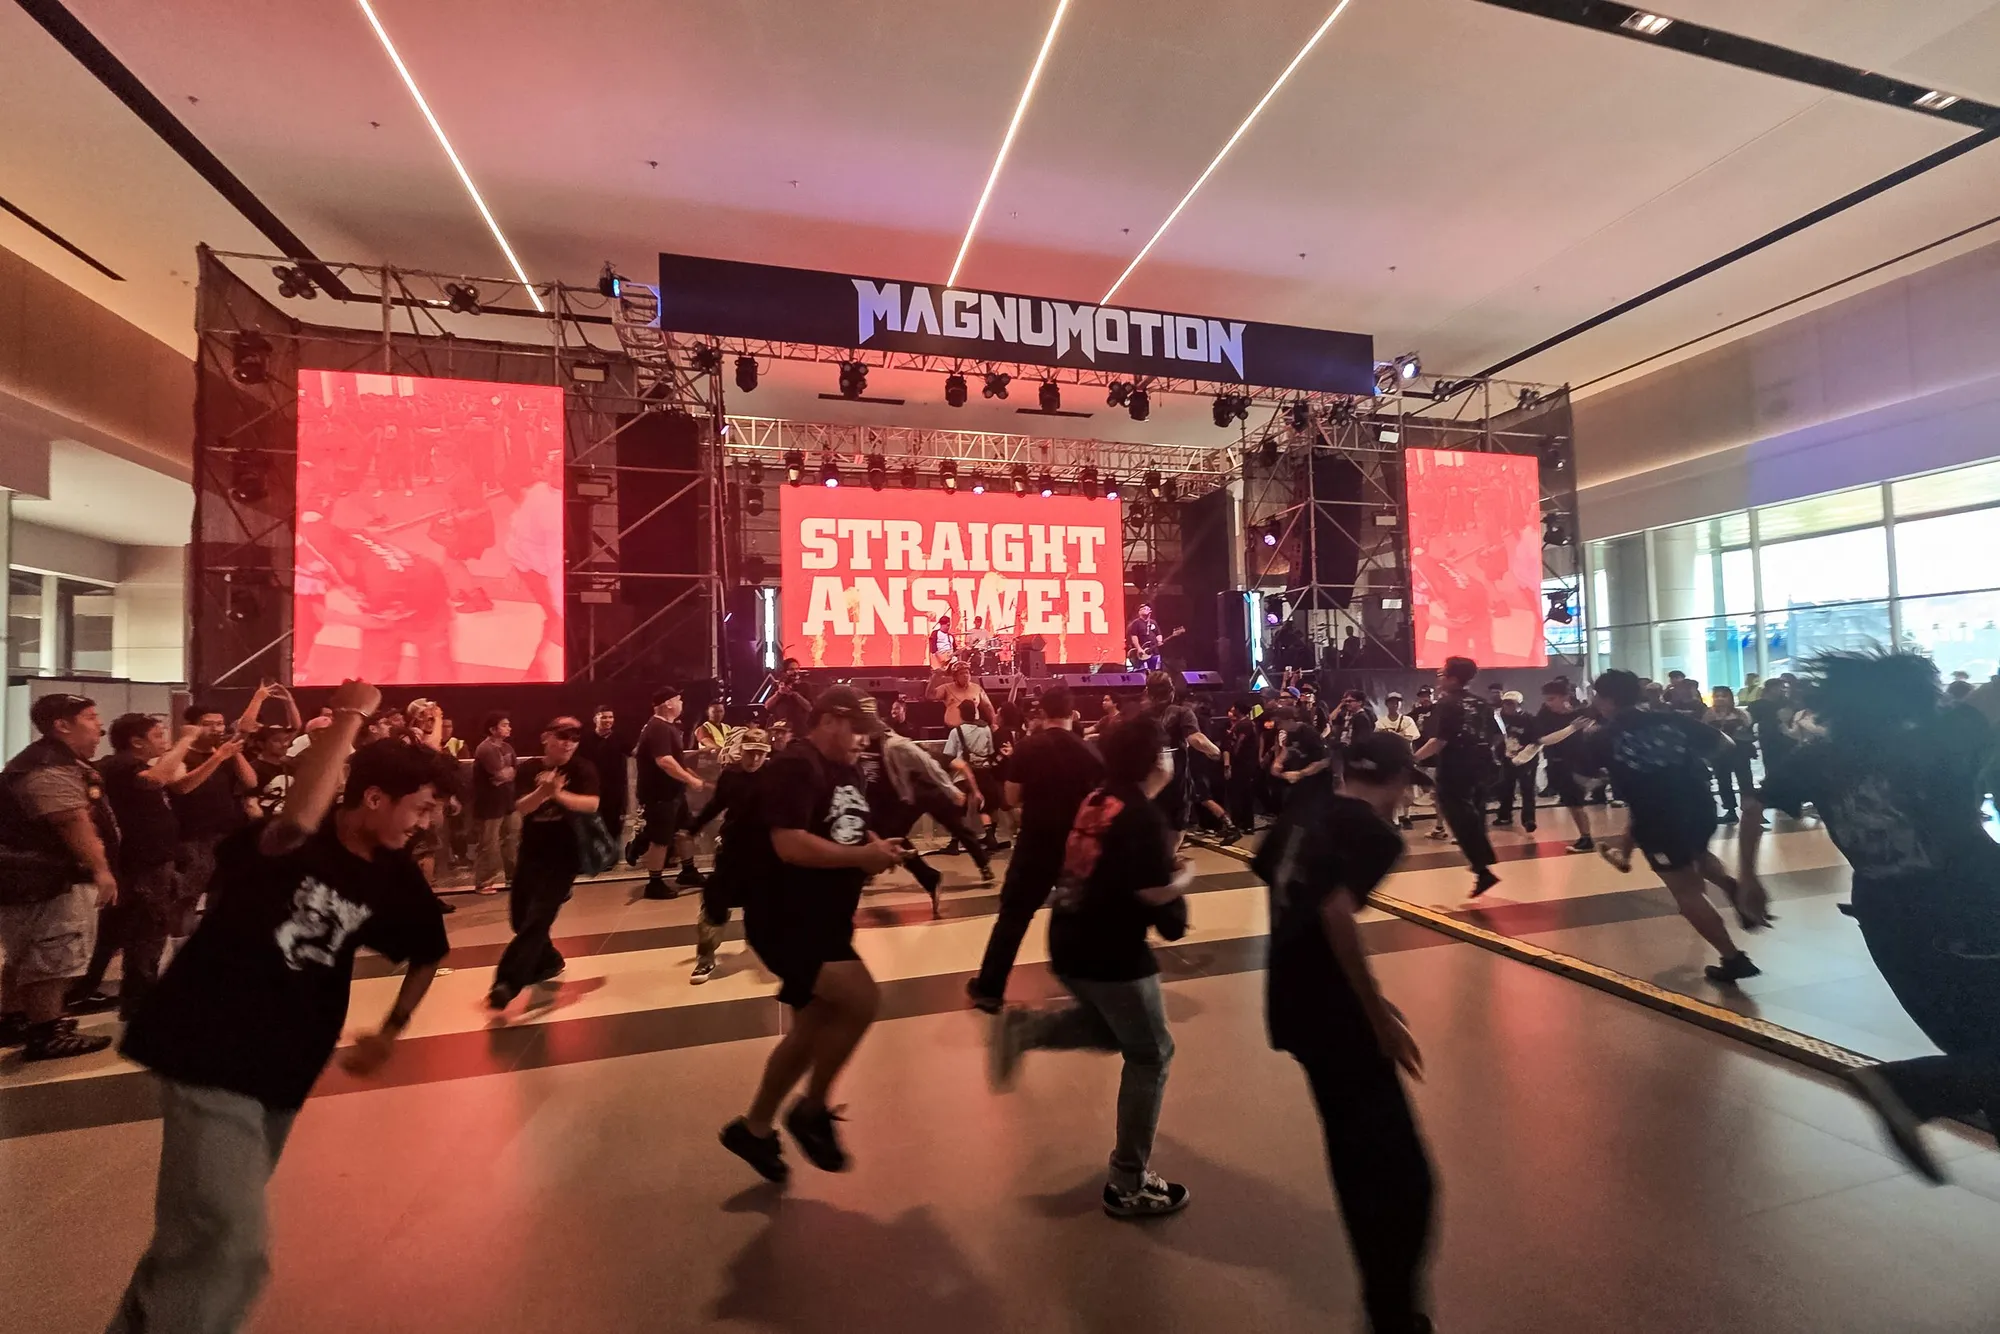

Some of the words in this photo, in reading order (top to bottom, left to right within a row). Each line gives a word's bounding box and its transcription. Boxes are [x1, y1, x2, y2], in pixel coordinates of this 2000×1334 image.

[851, 279, 1247, 380] MAGNUMOTION
[800, 517, 1106, 574] STRAIGHT
[802, 575, 1109, 636] ANSWER
